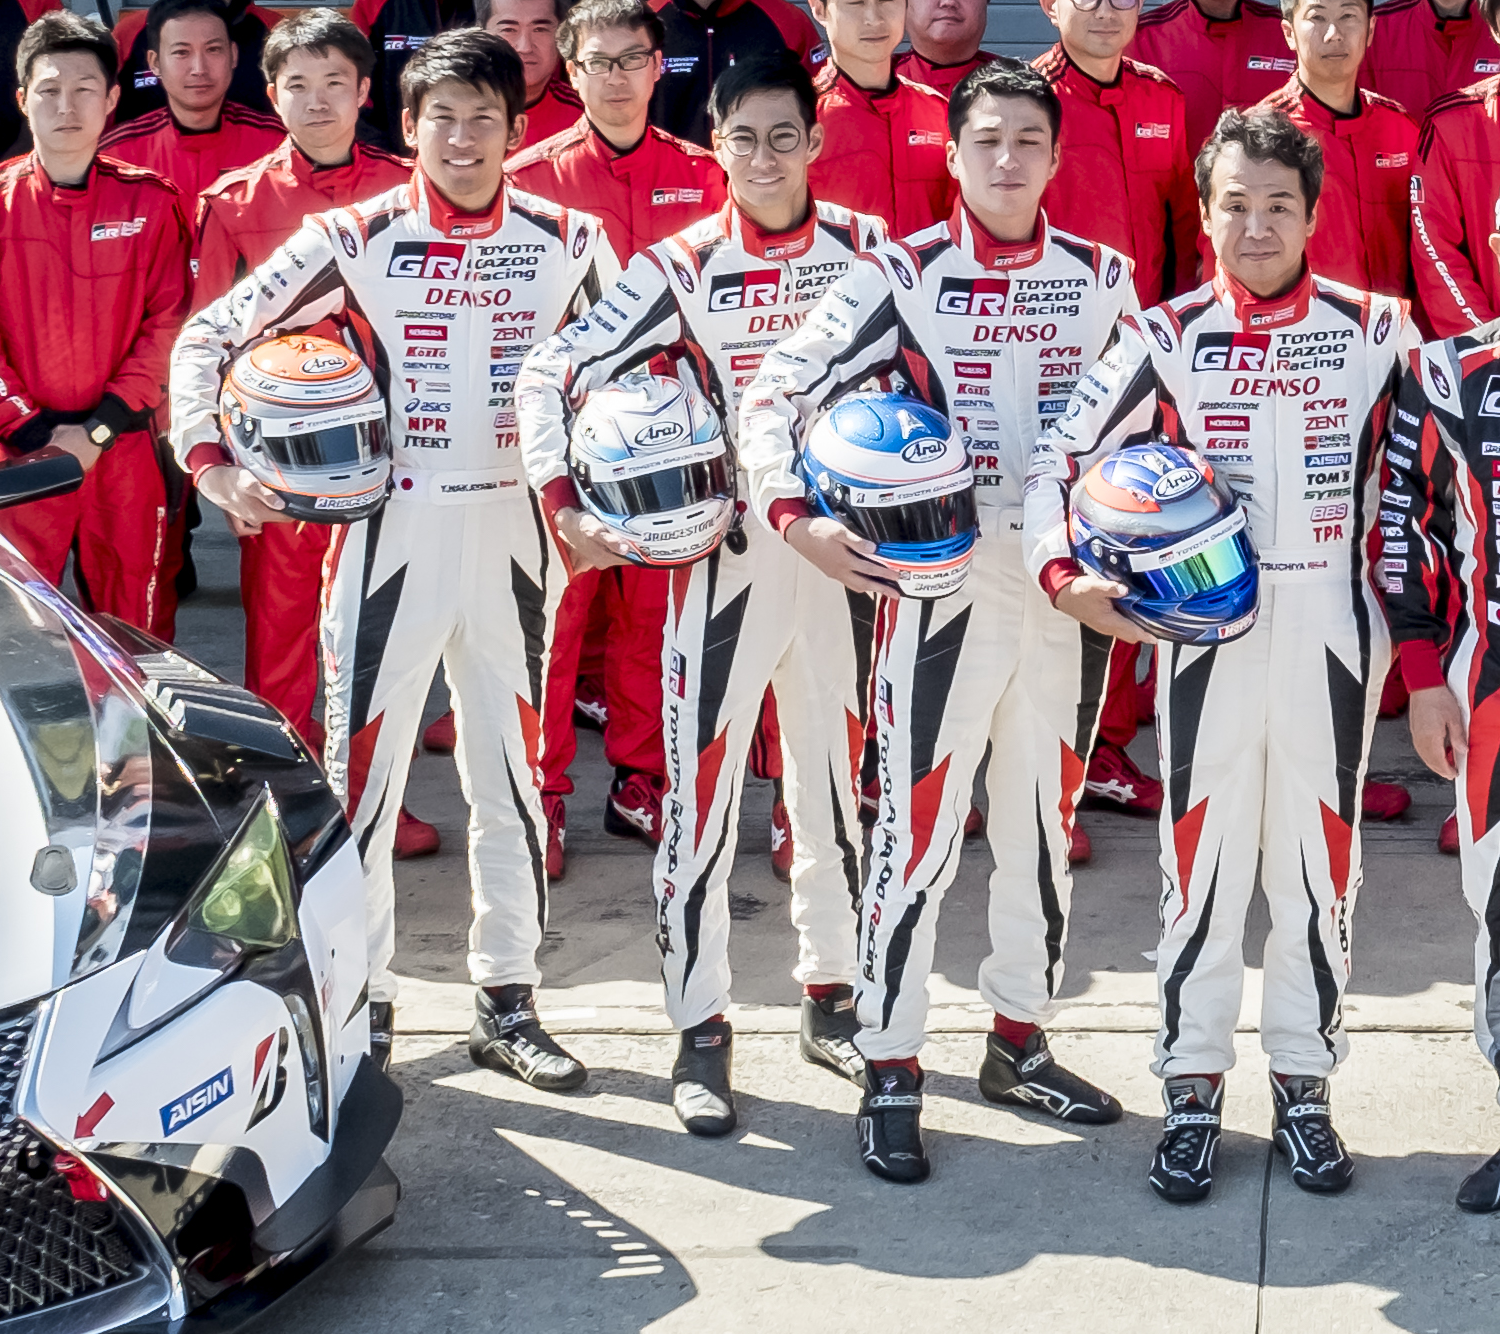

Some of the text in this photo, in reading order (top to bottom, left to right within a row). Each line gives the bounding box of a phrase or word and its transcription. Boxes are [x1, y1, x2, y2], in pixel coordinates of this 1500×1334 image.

[1277, 329, 1354, 345] TOYOTA
[1277, 344, 1347, 358] GAZOO
[1271, 357, 1344, 372] Racing
[1310, 455, 1349, 465] AISIN
[167, 1072, 231, 1129] AISIN
